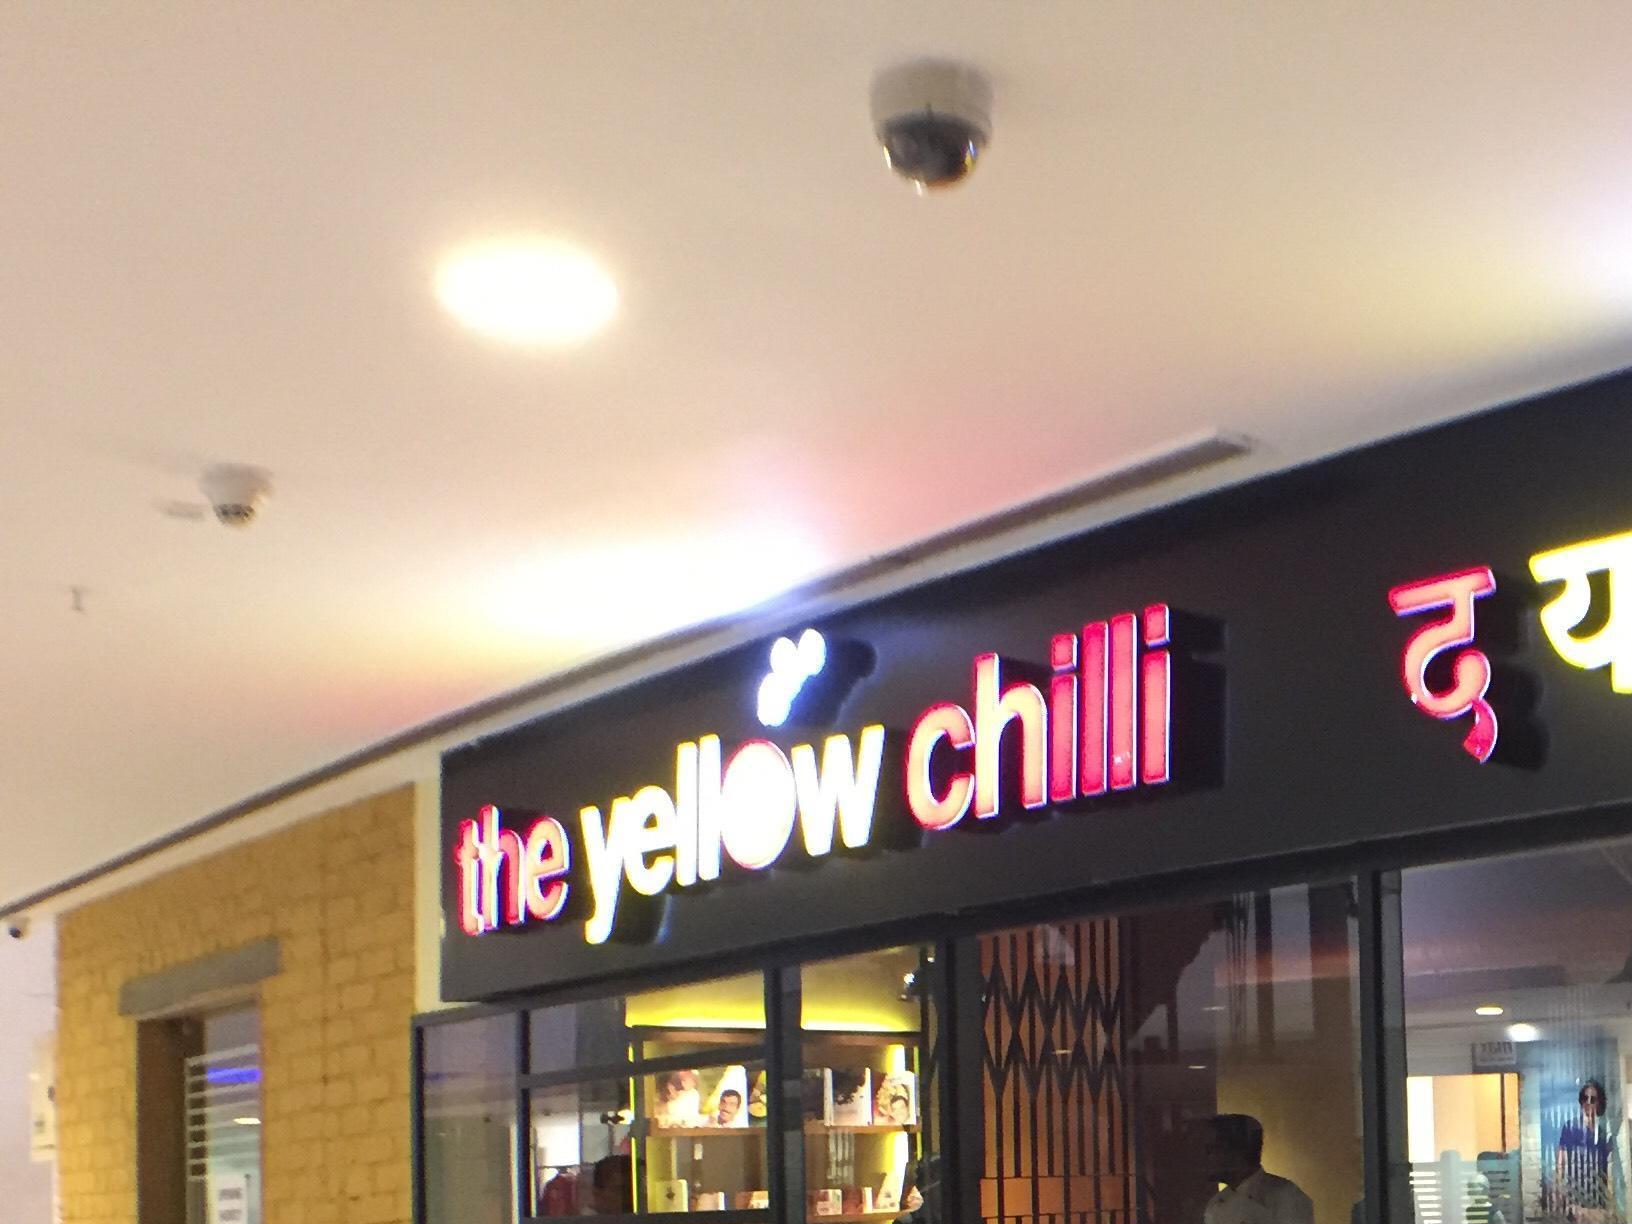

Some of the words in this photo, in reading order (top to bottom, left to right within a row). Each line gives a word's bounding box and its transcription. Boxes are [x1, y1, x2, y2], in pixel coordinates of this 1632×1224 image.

[455, 804, 571, 937] the
[579, 724, 885, 945] yellow
[905, 603, 1171, 831] chilli
[1388, 565, 1498, 763] द
